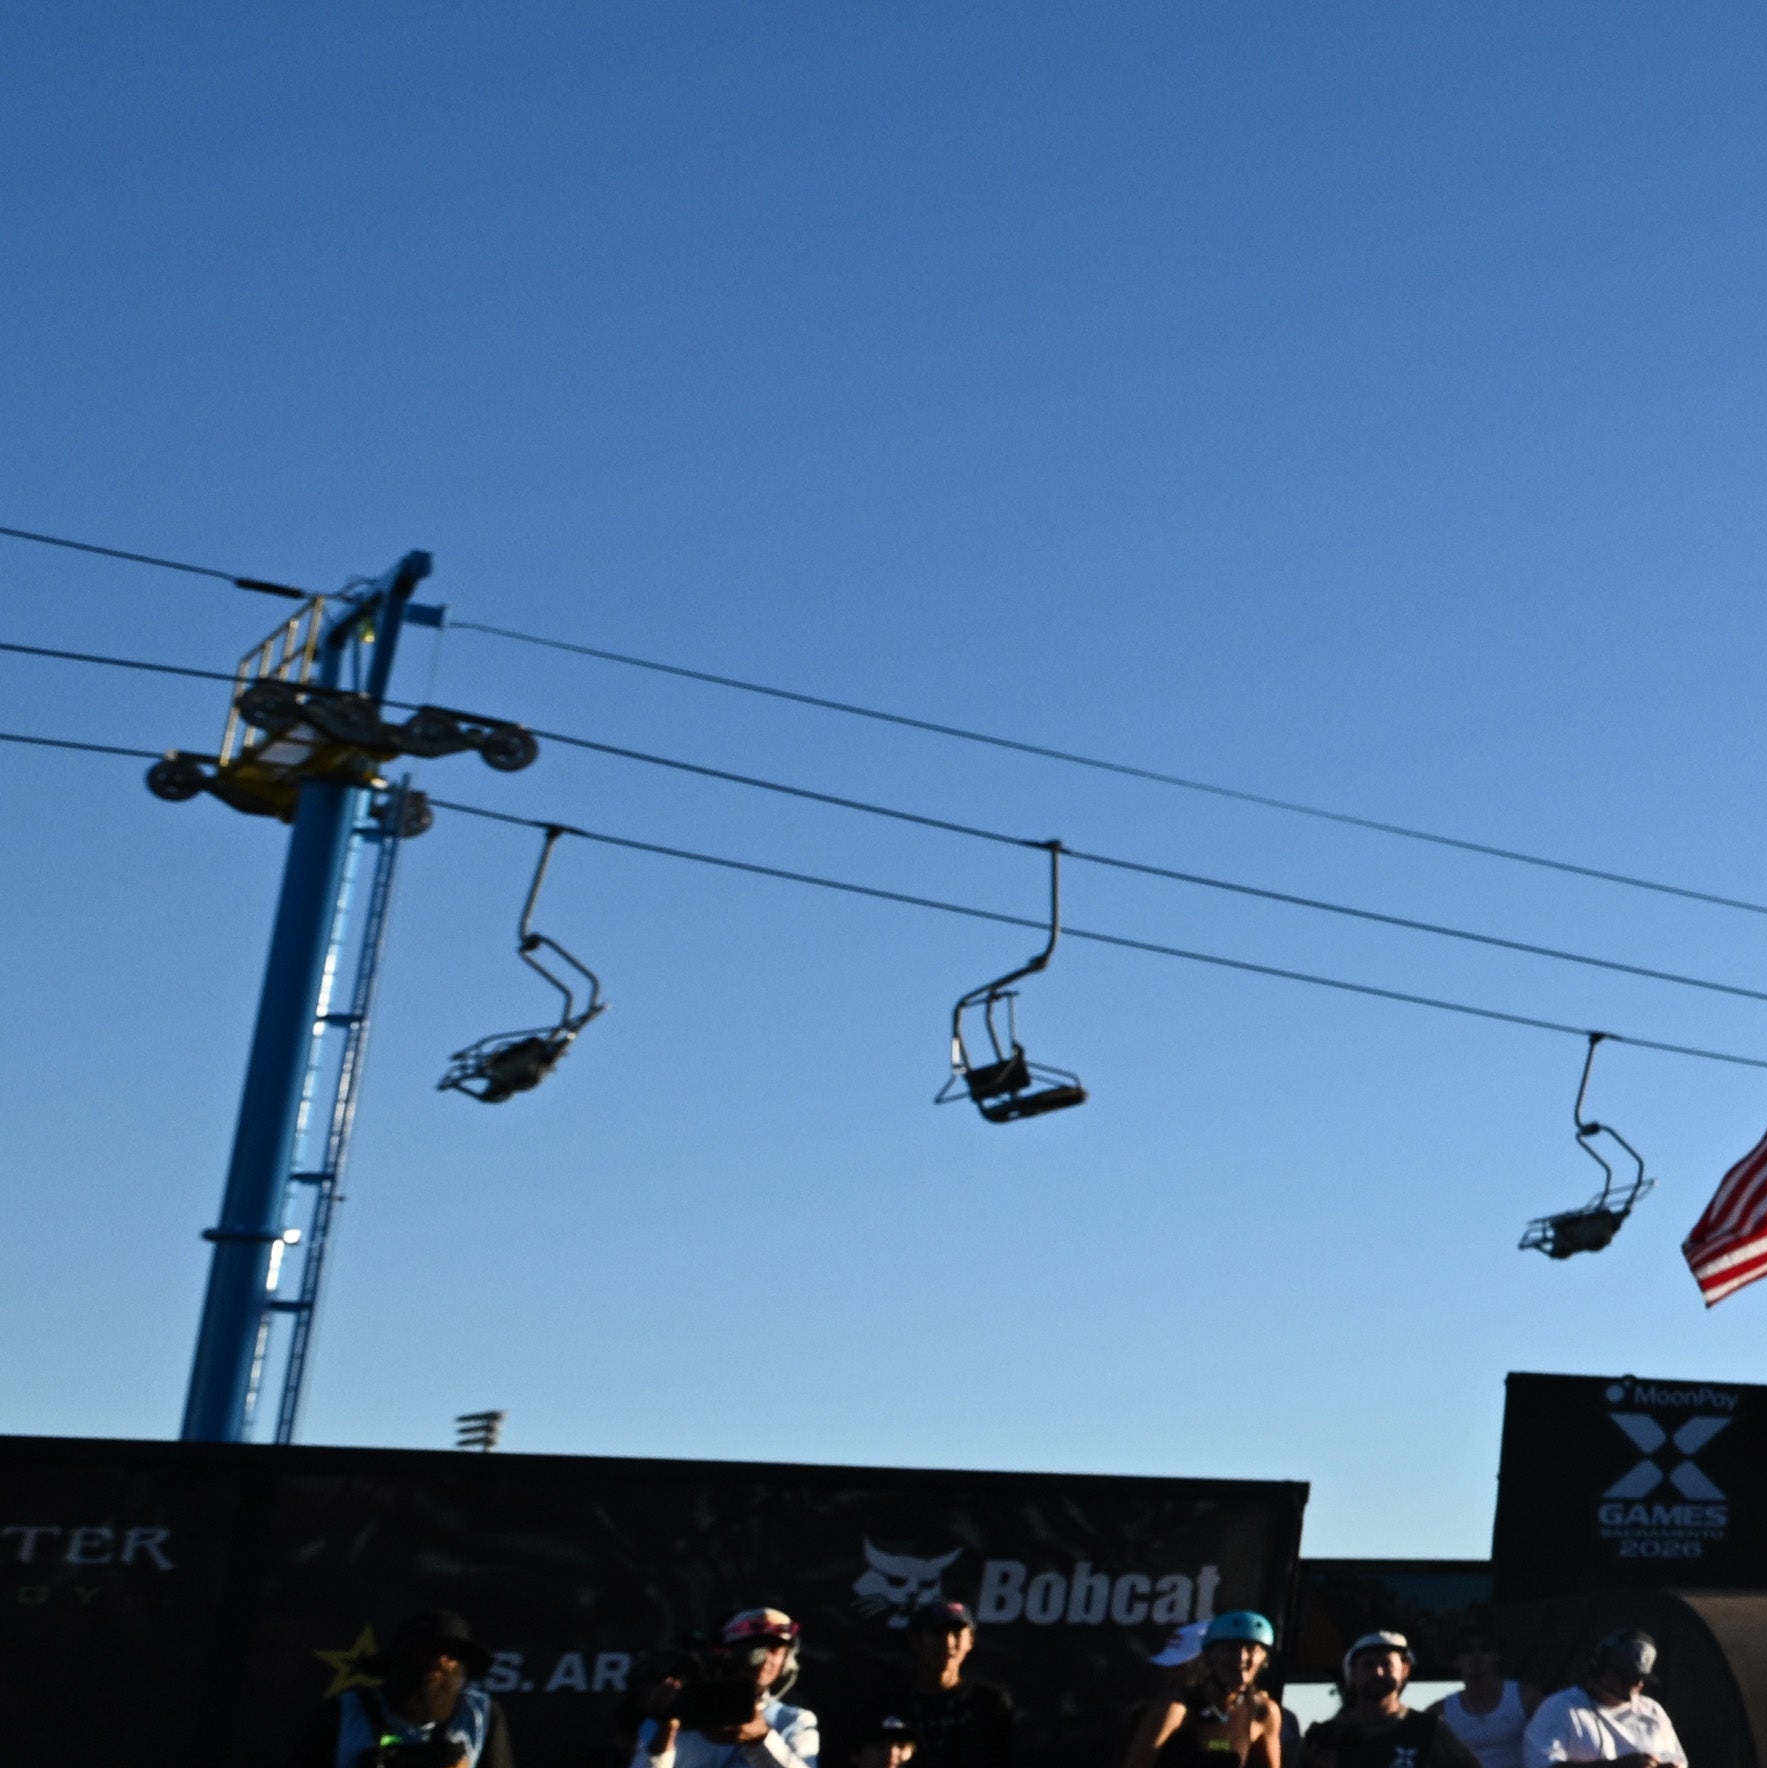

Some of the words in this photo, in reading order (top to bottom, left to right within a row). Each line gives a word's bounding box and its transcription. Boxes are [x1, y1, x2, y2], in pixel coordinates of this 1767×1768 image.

[1633, 1384, 1740, 1412] MoonPay
[1598, 1502, 1729, 1528] GAMES
[1618, 1539, 1703, 1559] 2026
[977, 1558, 1221, 1625] Bobcat
